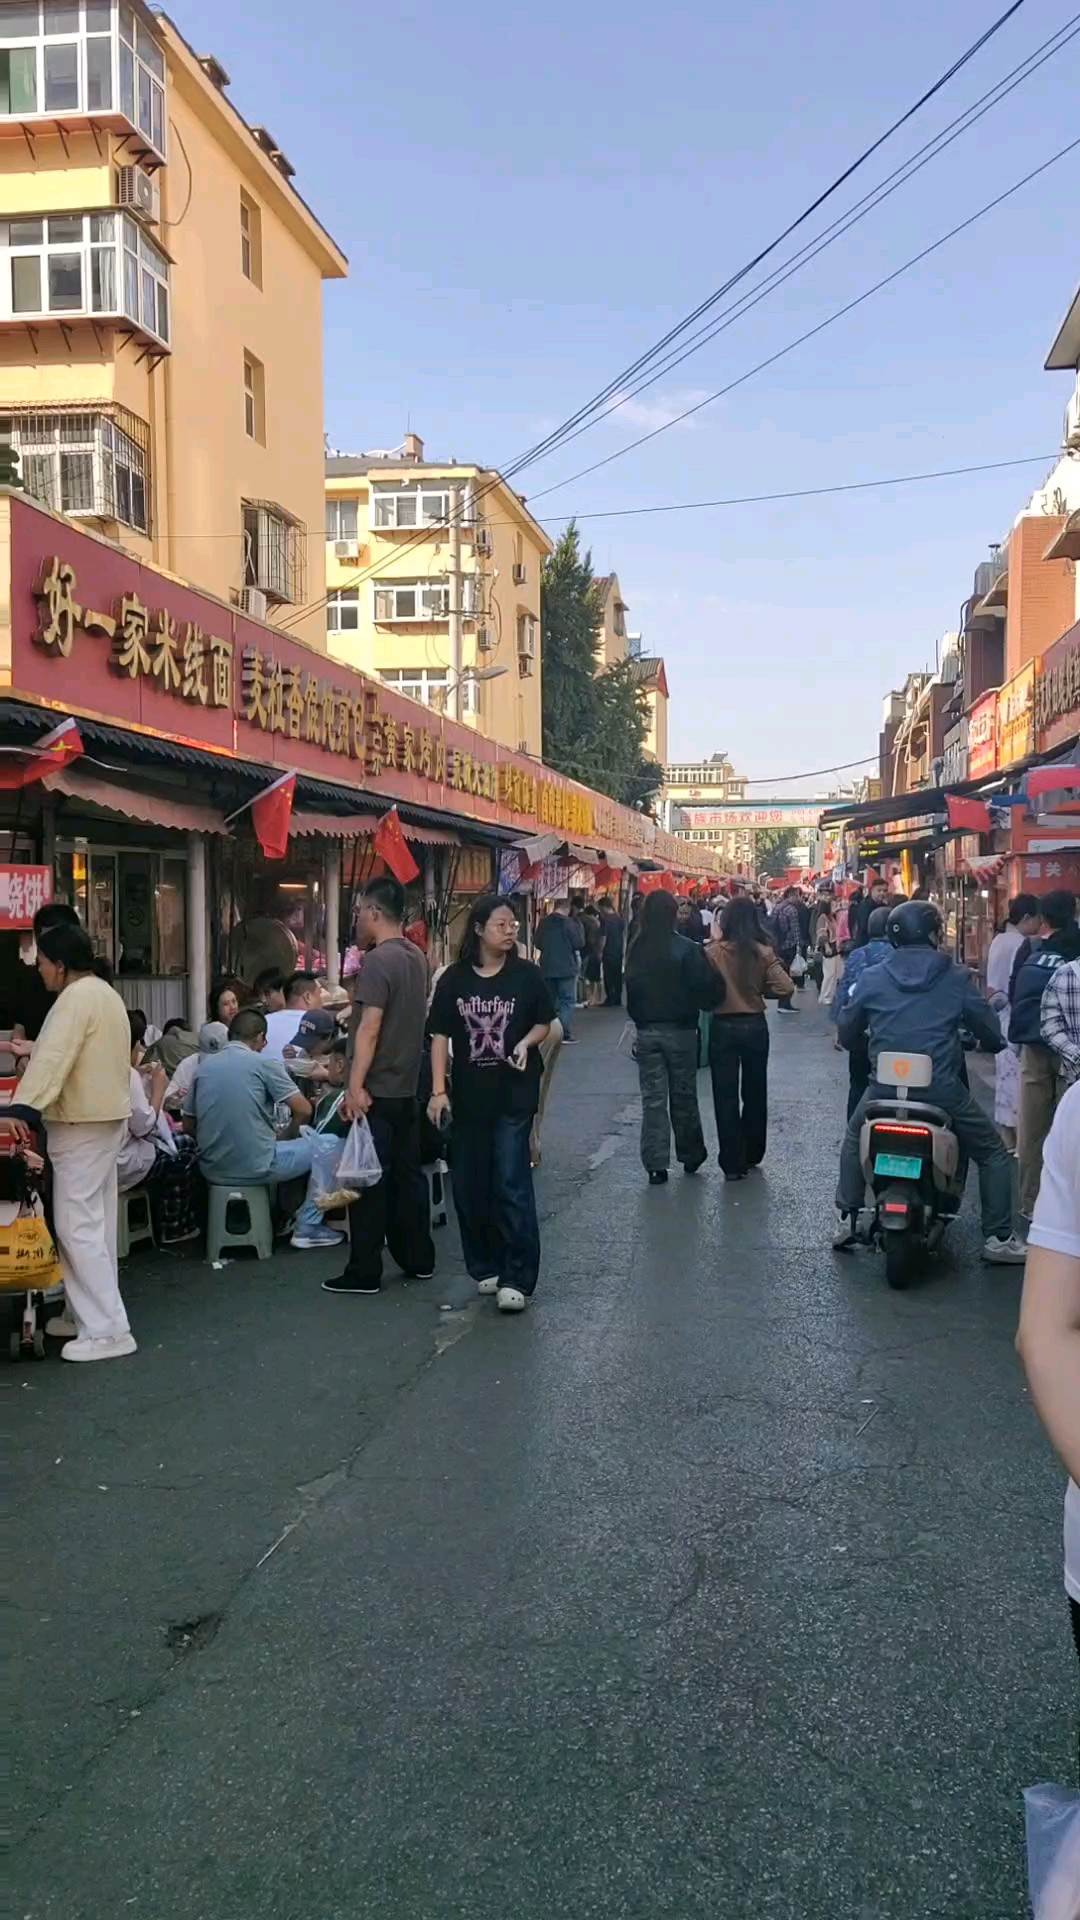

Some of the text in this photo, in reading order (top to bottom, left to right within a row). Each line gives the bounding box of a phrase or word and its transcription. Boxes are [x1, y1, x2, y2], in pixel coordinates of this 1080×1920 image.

[40, 556, 232, 708] 好一家米线面
[680, 809, 783, 826] 民族市场欢迎您
